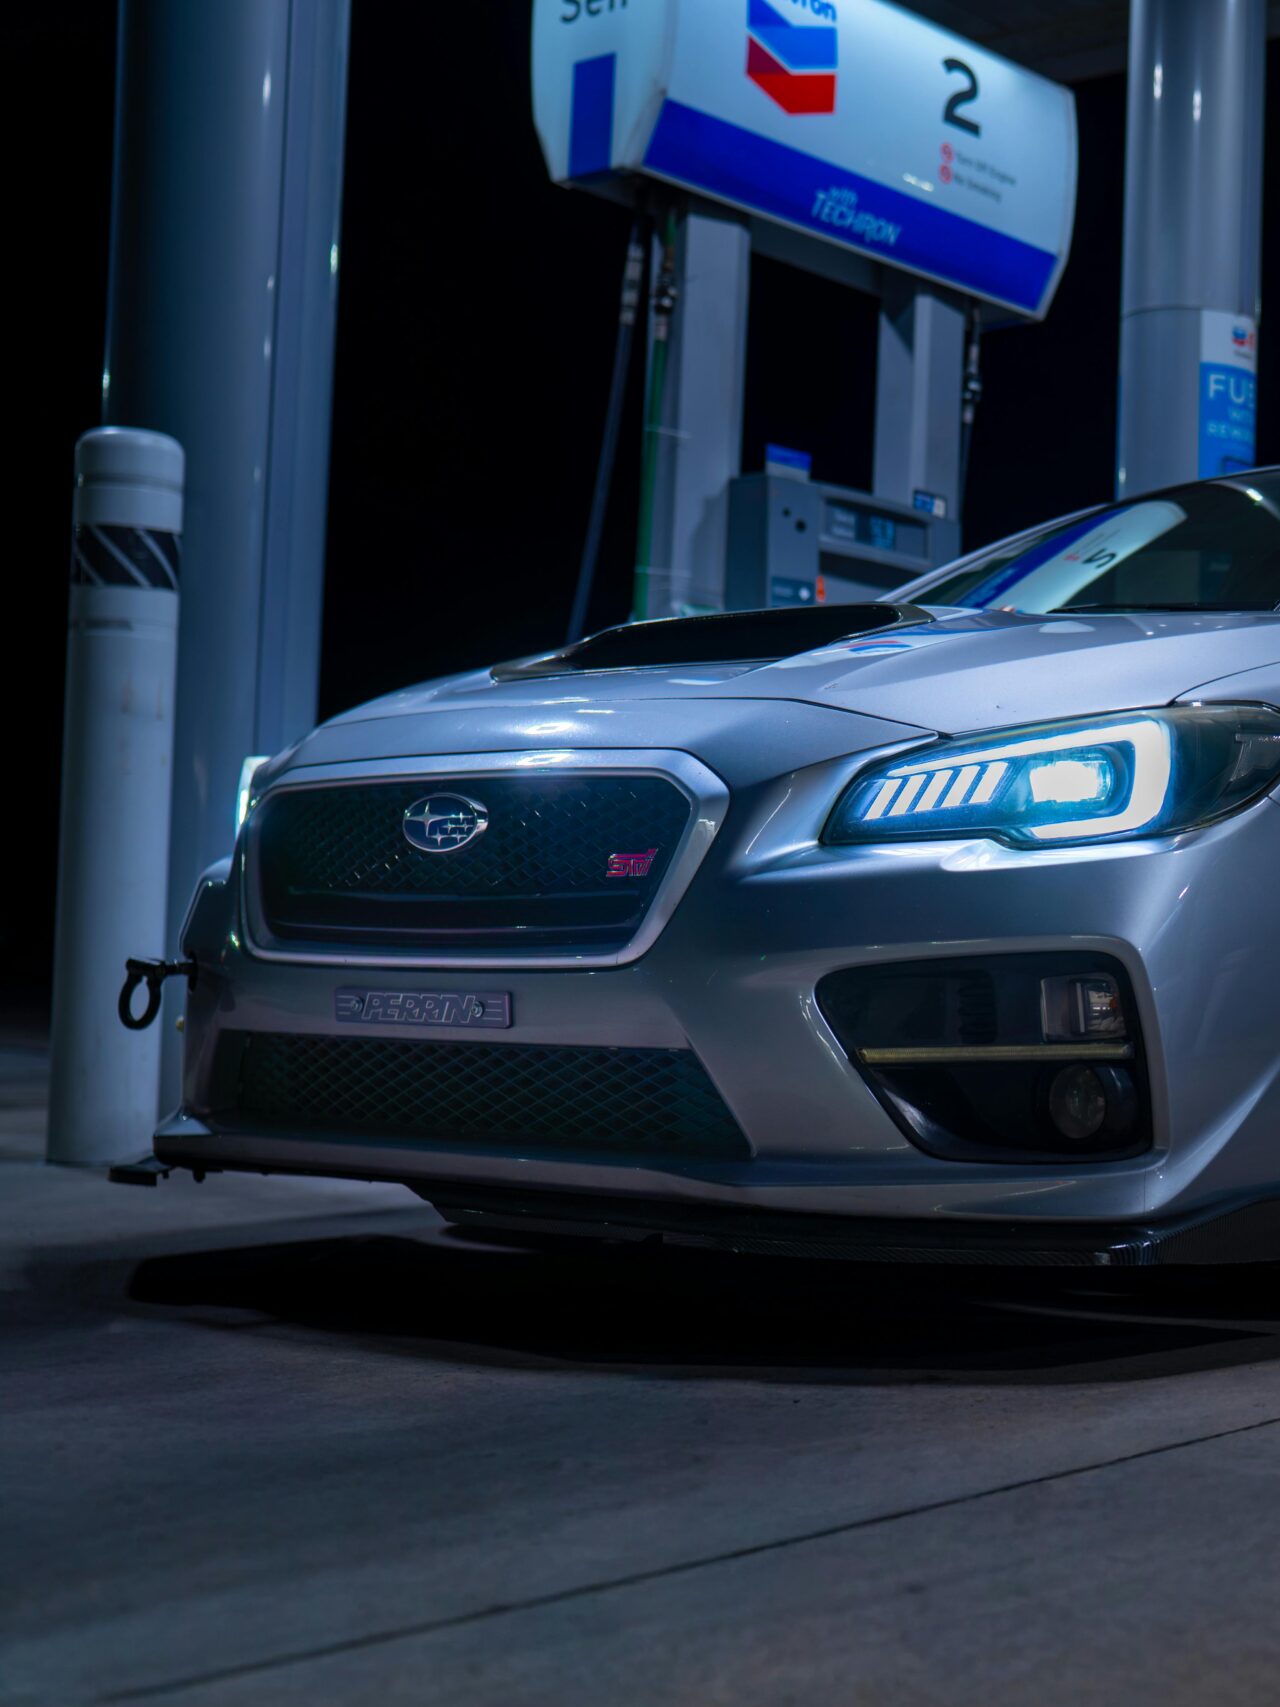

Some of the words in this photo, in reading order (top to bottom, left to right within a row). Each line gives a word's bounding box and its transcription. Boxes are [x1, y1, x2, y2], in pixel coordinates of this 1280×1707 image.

[942, 57, 982, 139] 2
[811, 190, 902, 247] TECHRON
[361, 992, 476, 1024] PERRIN
